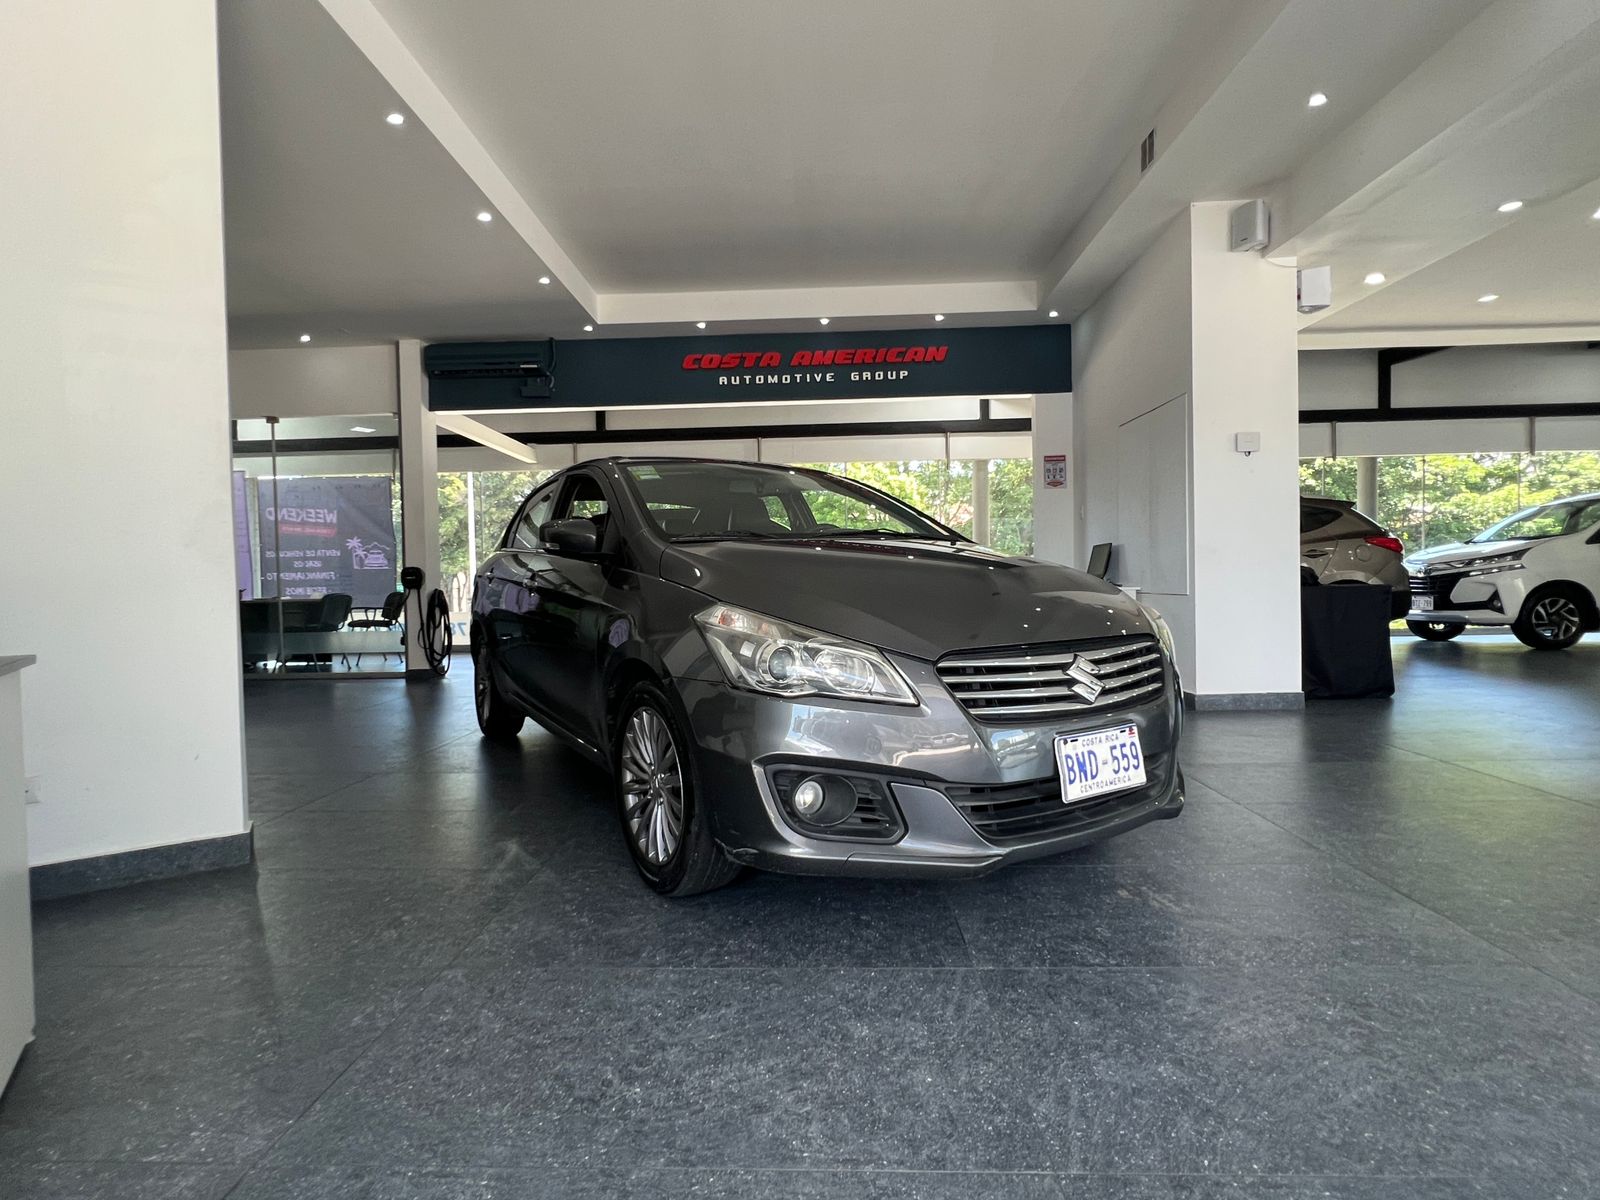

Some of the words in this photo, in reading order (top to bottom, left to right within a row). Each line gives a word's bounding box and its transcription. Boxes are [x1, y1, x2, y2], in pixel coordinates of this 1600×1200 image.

[682, 351, 781, 370] COSTA
[791, 346, 948, 367] AMERICAN
[719, 373, 835, 386] AUTOMOTIVE
[851, 370, 909, 382] GROUP
[1081, 737, 1103, 747] COSTA
[1105, 733, 1119, 743] RICA
[1064, 741, 1140, 785] BND-559
[1080, 776, 1132, 794] CENTROAMERICA
